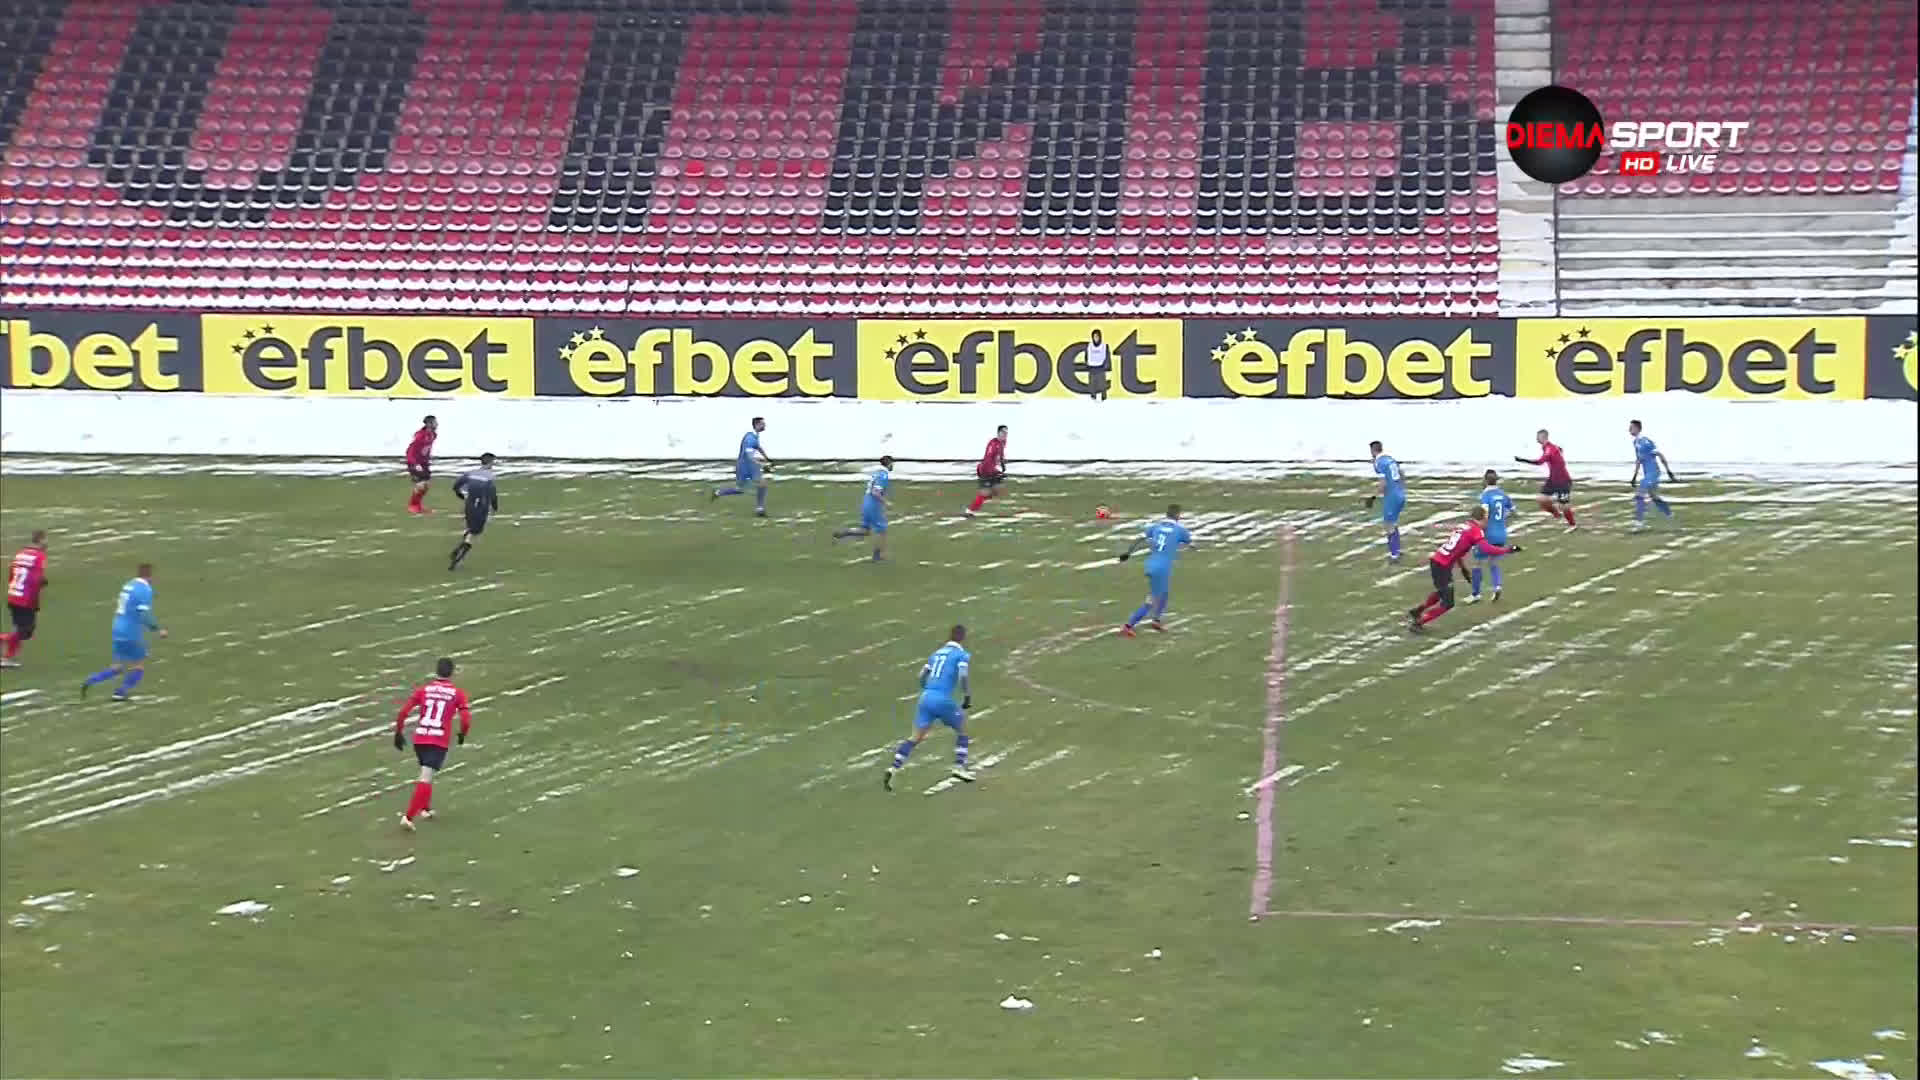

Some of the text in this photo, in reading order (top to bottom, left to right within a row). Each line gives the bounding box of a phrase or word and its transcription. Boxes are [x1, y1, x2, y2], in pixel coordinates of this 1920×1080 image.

[0, 320, 180, 391] bet
[242, 326, 508, 393] efbet
[568, 327, 833, 396] efbet
[1220, 328, 1492, 396] efbet
[1554, 328, 1836, 394] efbet
[1494, 501, 1503, 521] 3
[420, 699, 447, 728] 11
